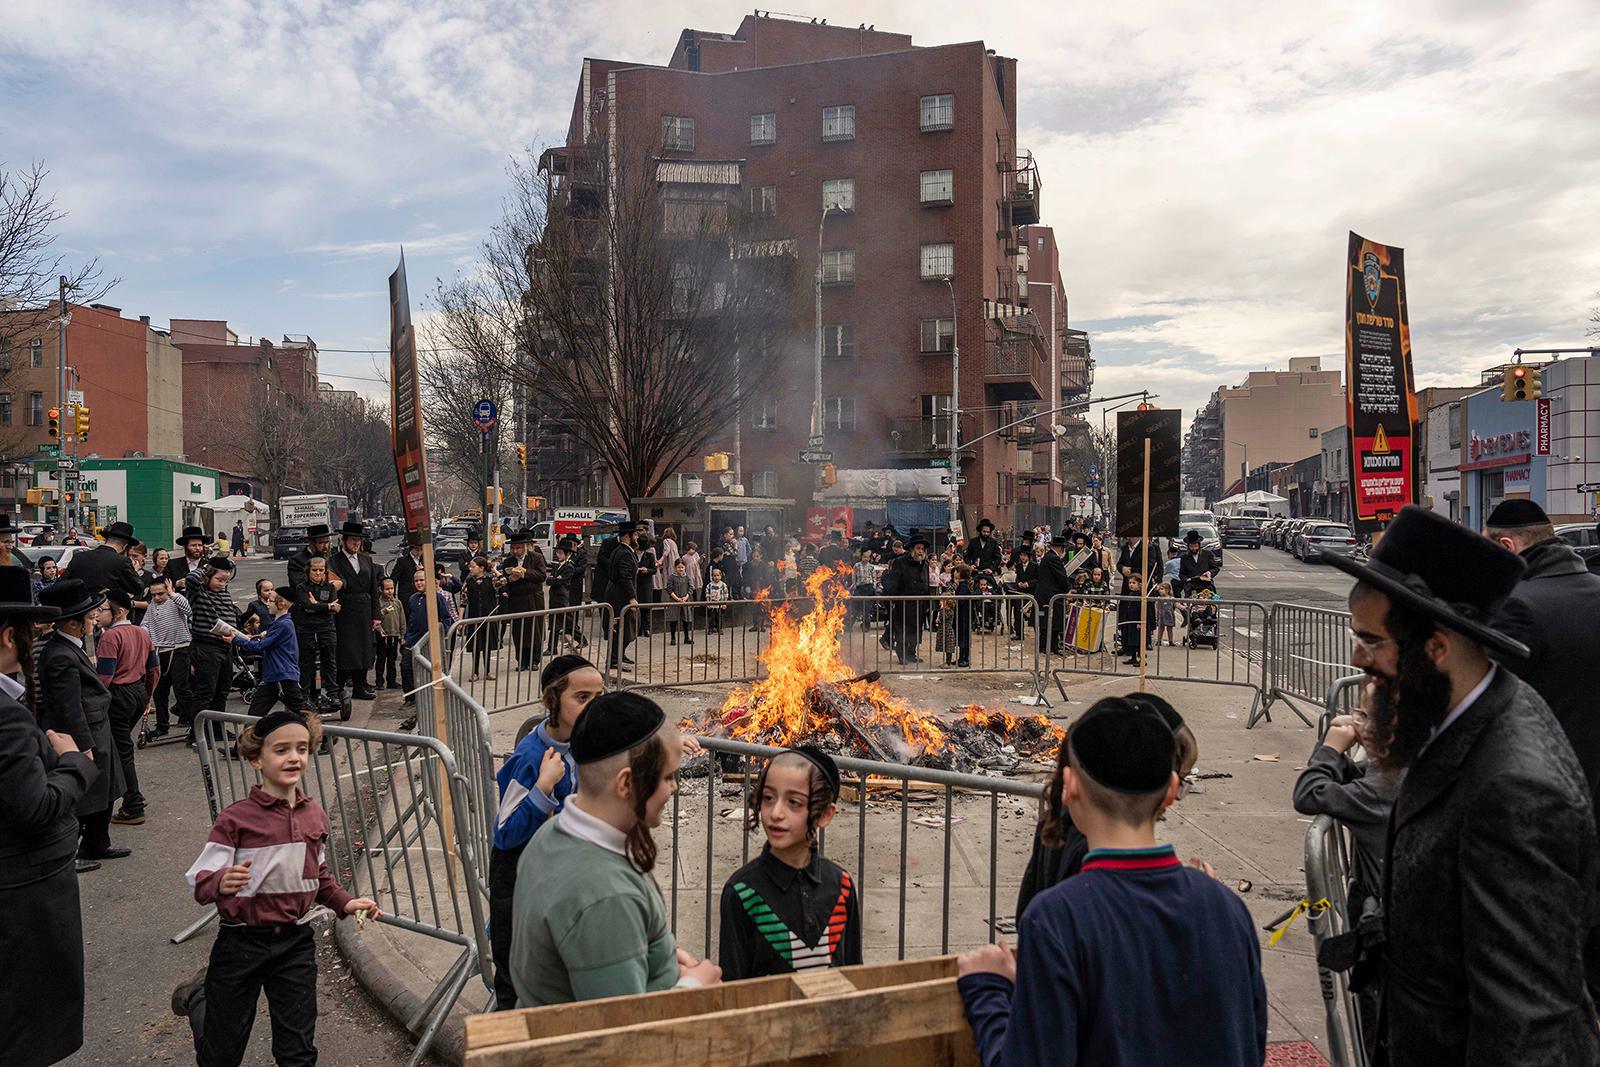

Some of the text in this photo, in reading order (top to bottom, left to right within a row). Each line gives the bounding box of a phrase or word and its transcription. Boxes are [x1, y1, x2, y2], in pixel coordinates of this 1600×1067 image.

[1540, 403, 1549, 451] PHARMACY
[65, 479, 97, 491] Bicotti
[1505, 468, 1530, 482] PHARMACY
[1320, 971, 1334, 1000] YPD
